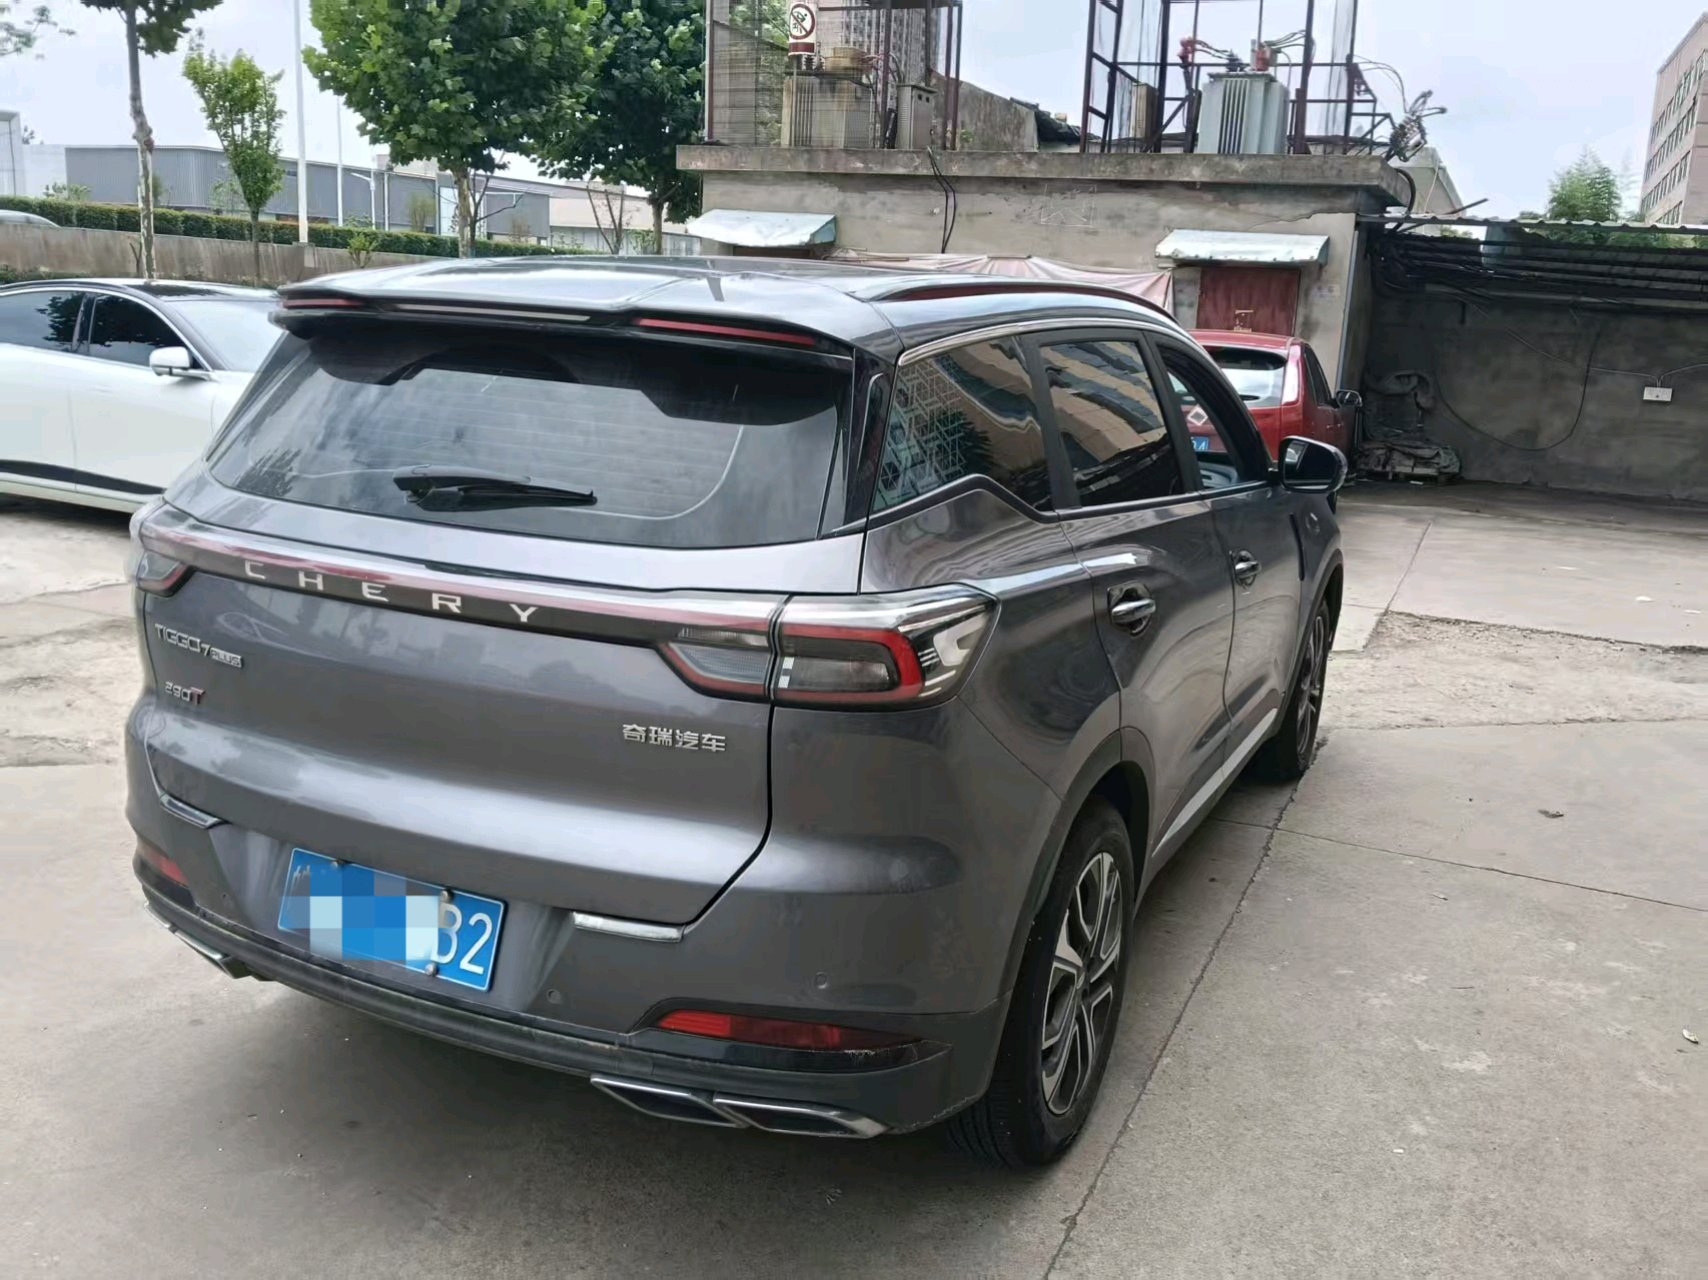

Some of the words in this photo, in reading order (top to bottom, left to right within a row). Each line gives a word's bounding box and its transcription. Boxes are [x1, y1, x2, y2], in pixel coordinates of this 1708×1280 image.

[245, 560, 537, 623] CHERY
[165, 681, 205, 705] 290T
[623, 724, 726, 752] 奇瑞汽车
